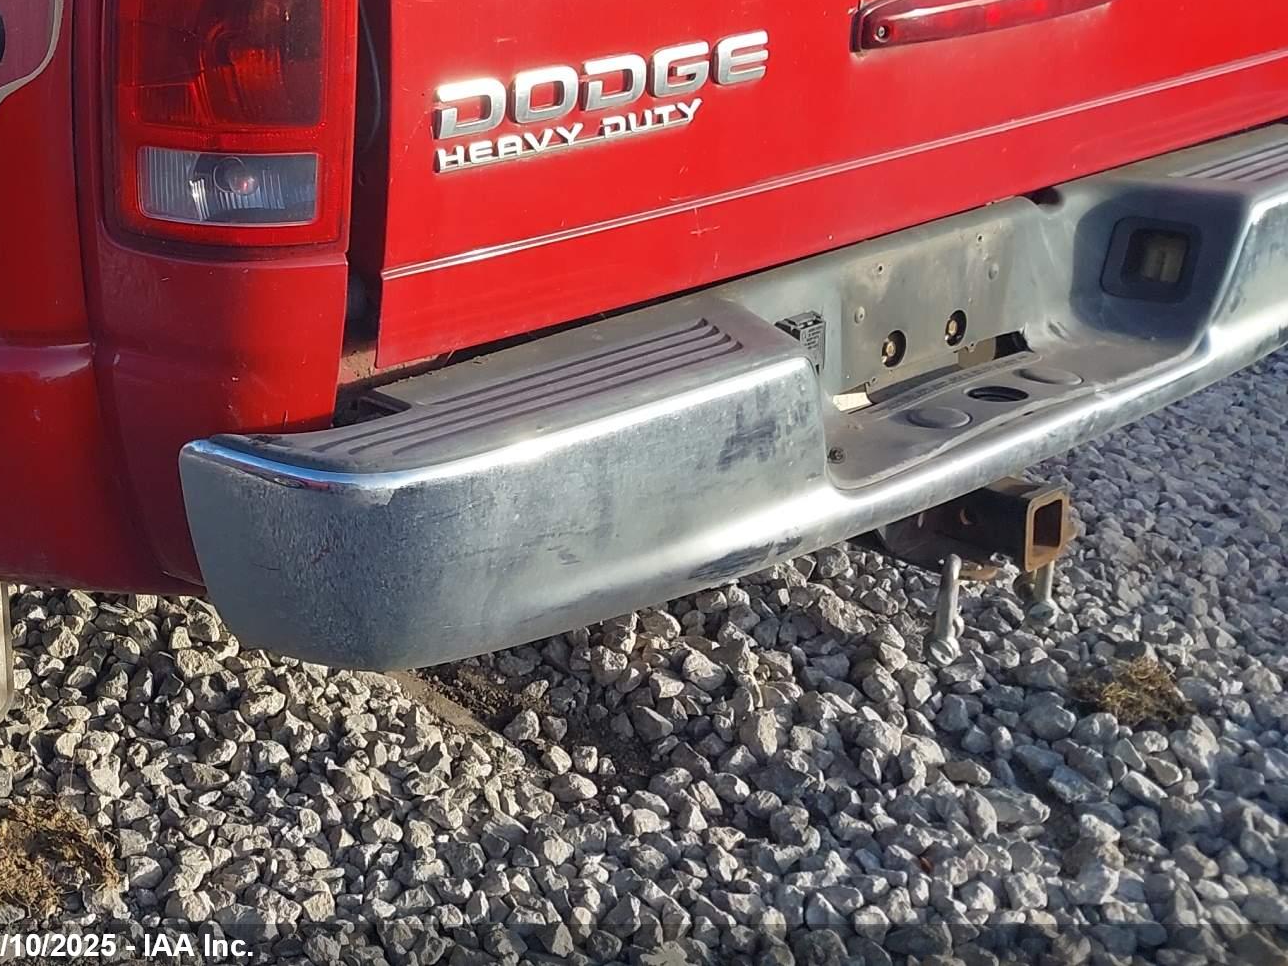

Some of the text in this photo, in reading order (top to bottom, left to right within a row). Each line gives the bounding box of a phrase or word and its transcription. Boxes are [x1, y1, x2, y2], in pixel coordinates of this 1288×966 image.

[434, 30, 769, 140] DODGE
[435, 98, 703, 173] HEAVY DUTY
